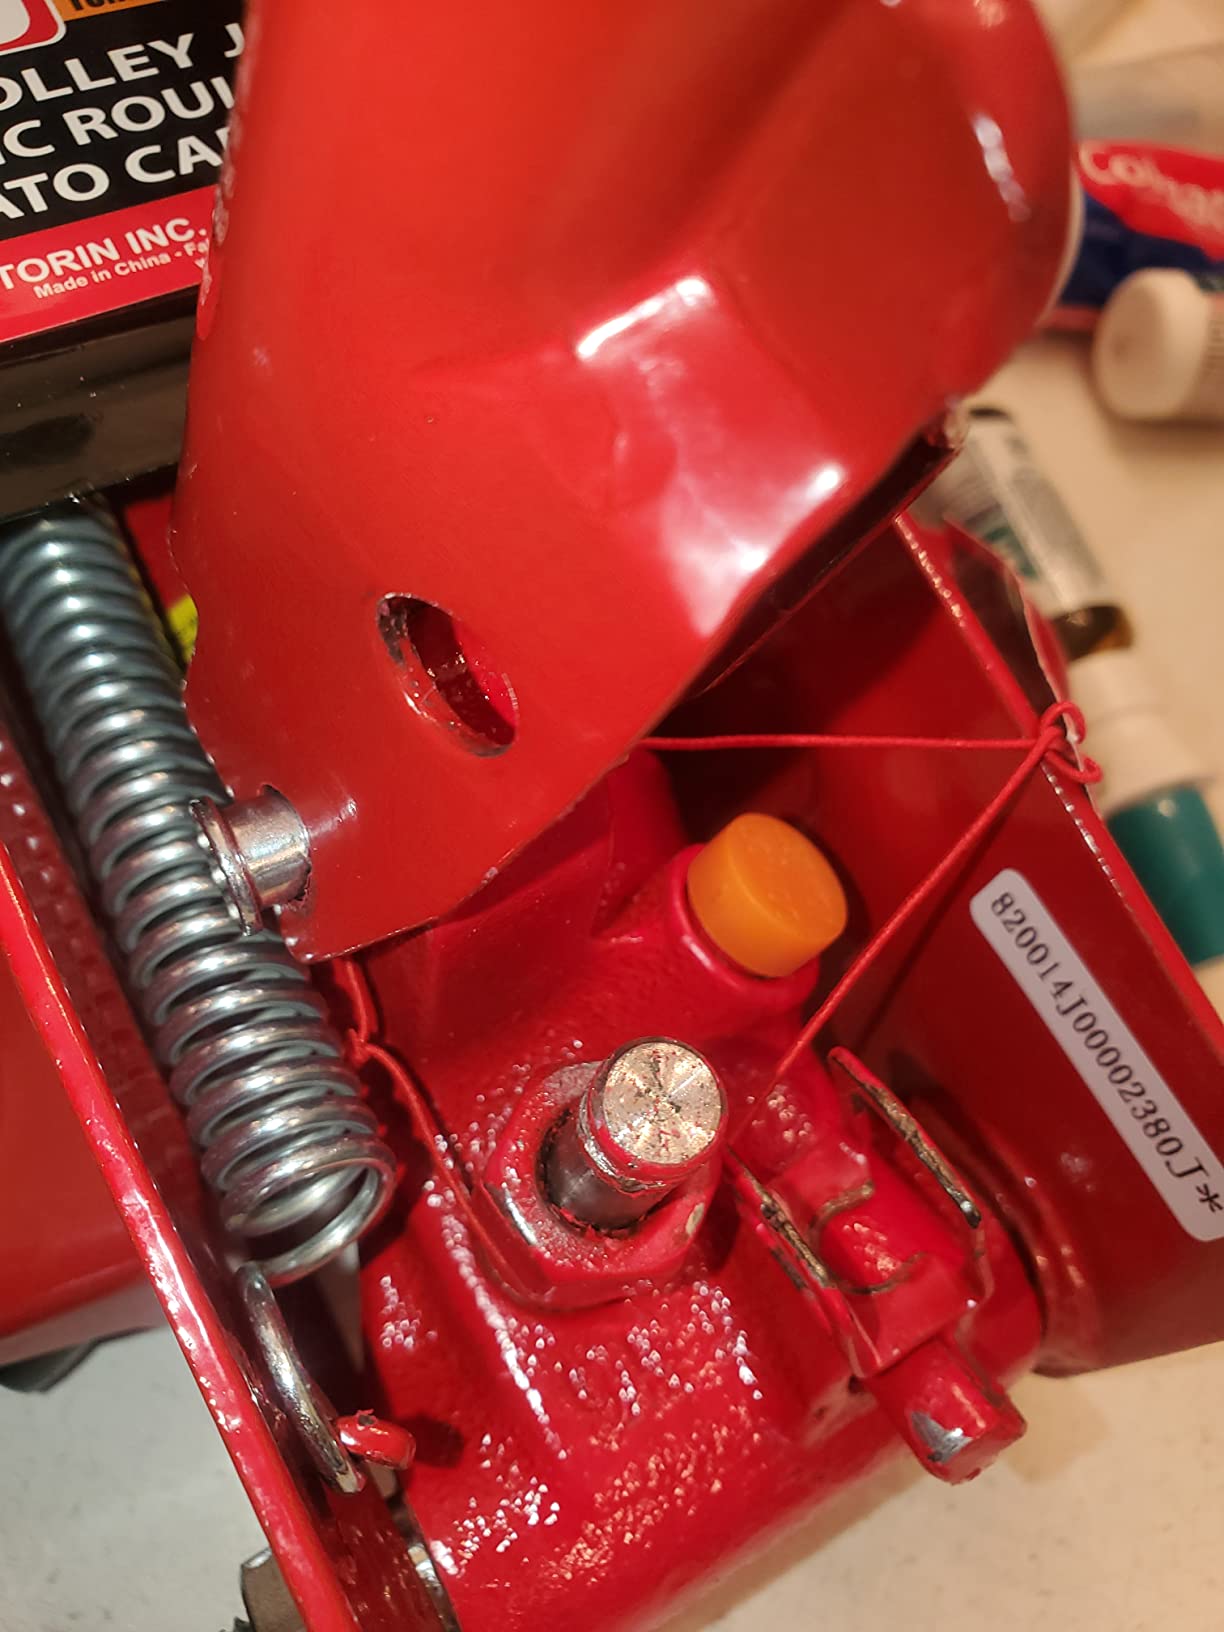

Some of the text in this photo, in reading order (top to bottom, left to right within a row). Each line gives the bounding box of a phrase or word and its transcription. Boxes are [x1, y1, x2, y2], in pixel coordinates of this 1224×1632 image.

[0, 218, 207, 290] TORIN INC.
[33, 275, 89, 299] Made
[91, 269, 112, 284] in
[114, 252, 172, 276] China
